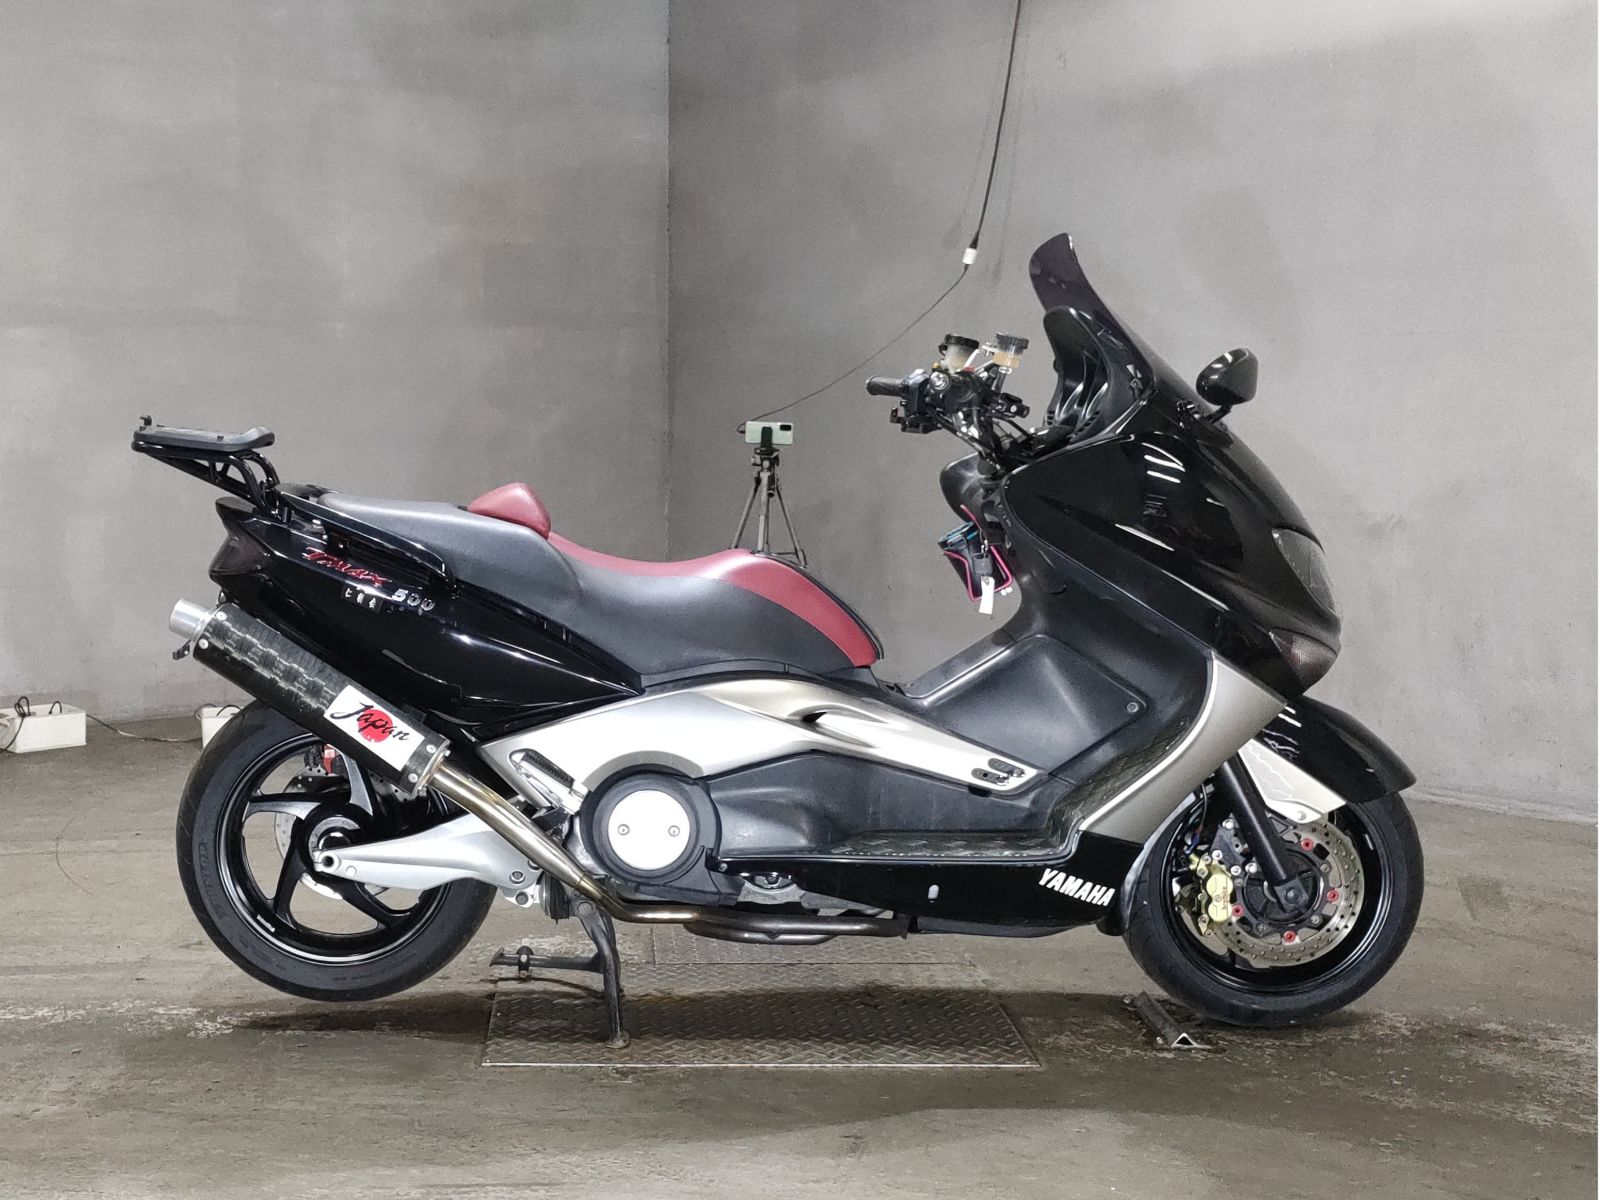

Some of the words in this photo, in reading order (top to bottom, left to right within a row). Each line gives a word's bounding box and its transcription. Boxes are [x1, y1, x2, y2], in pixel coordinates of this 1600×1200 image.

[392, 589, 435, 611] 500
[329, 701, 410, 741] Japan
[1039, 868, 1116, 907] YAMAHA
